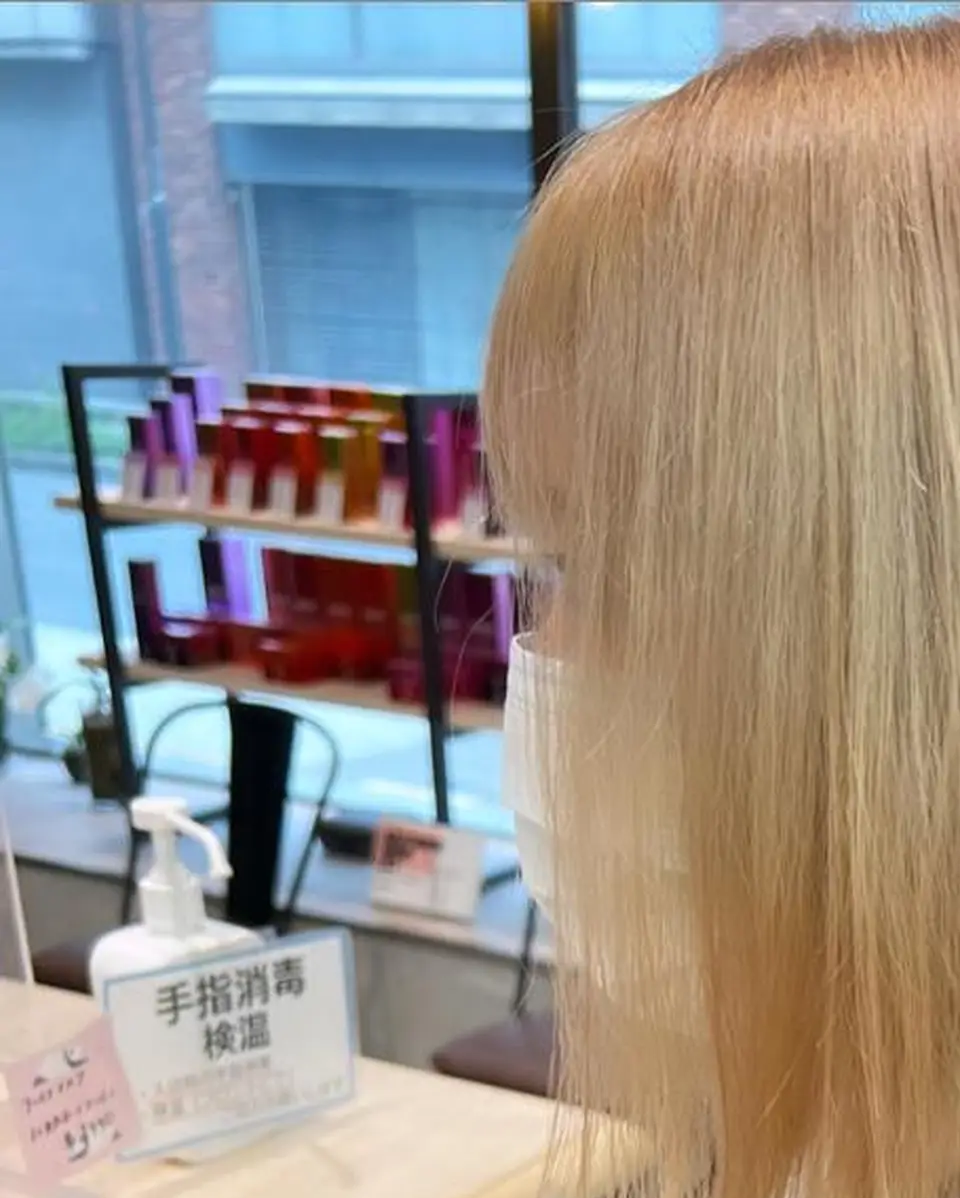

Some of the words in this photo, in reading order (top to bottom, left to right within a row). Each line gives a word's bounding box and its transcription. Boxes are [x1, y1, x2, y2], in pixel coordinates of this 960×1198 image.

[156, 956, 306, 1027] 手指消毒
[203, 1011, 271, 1060] 検温
